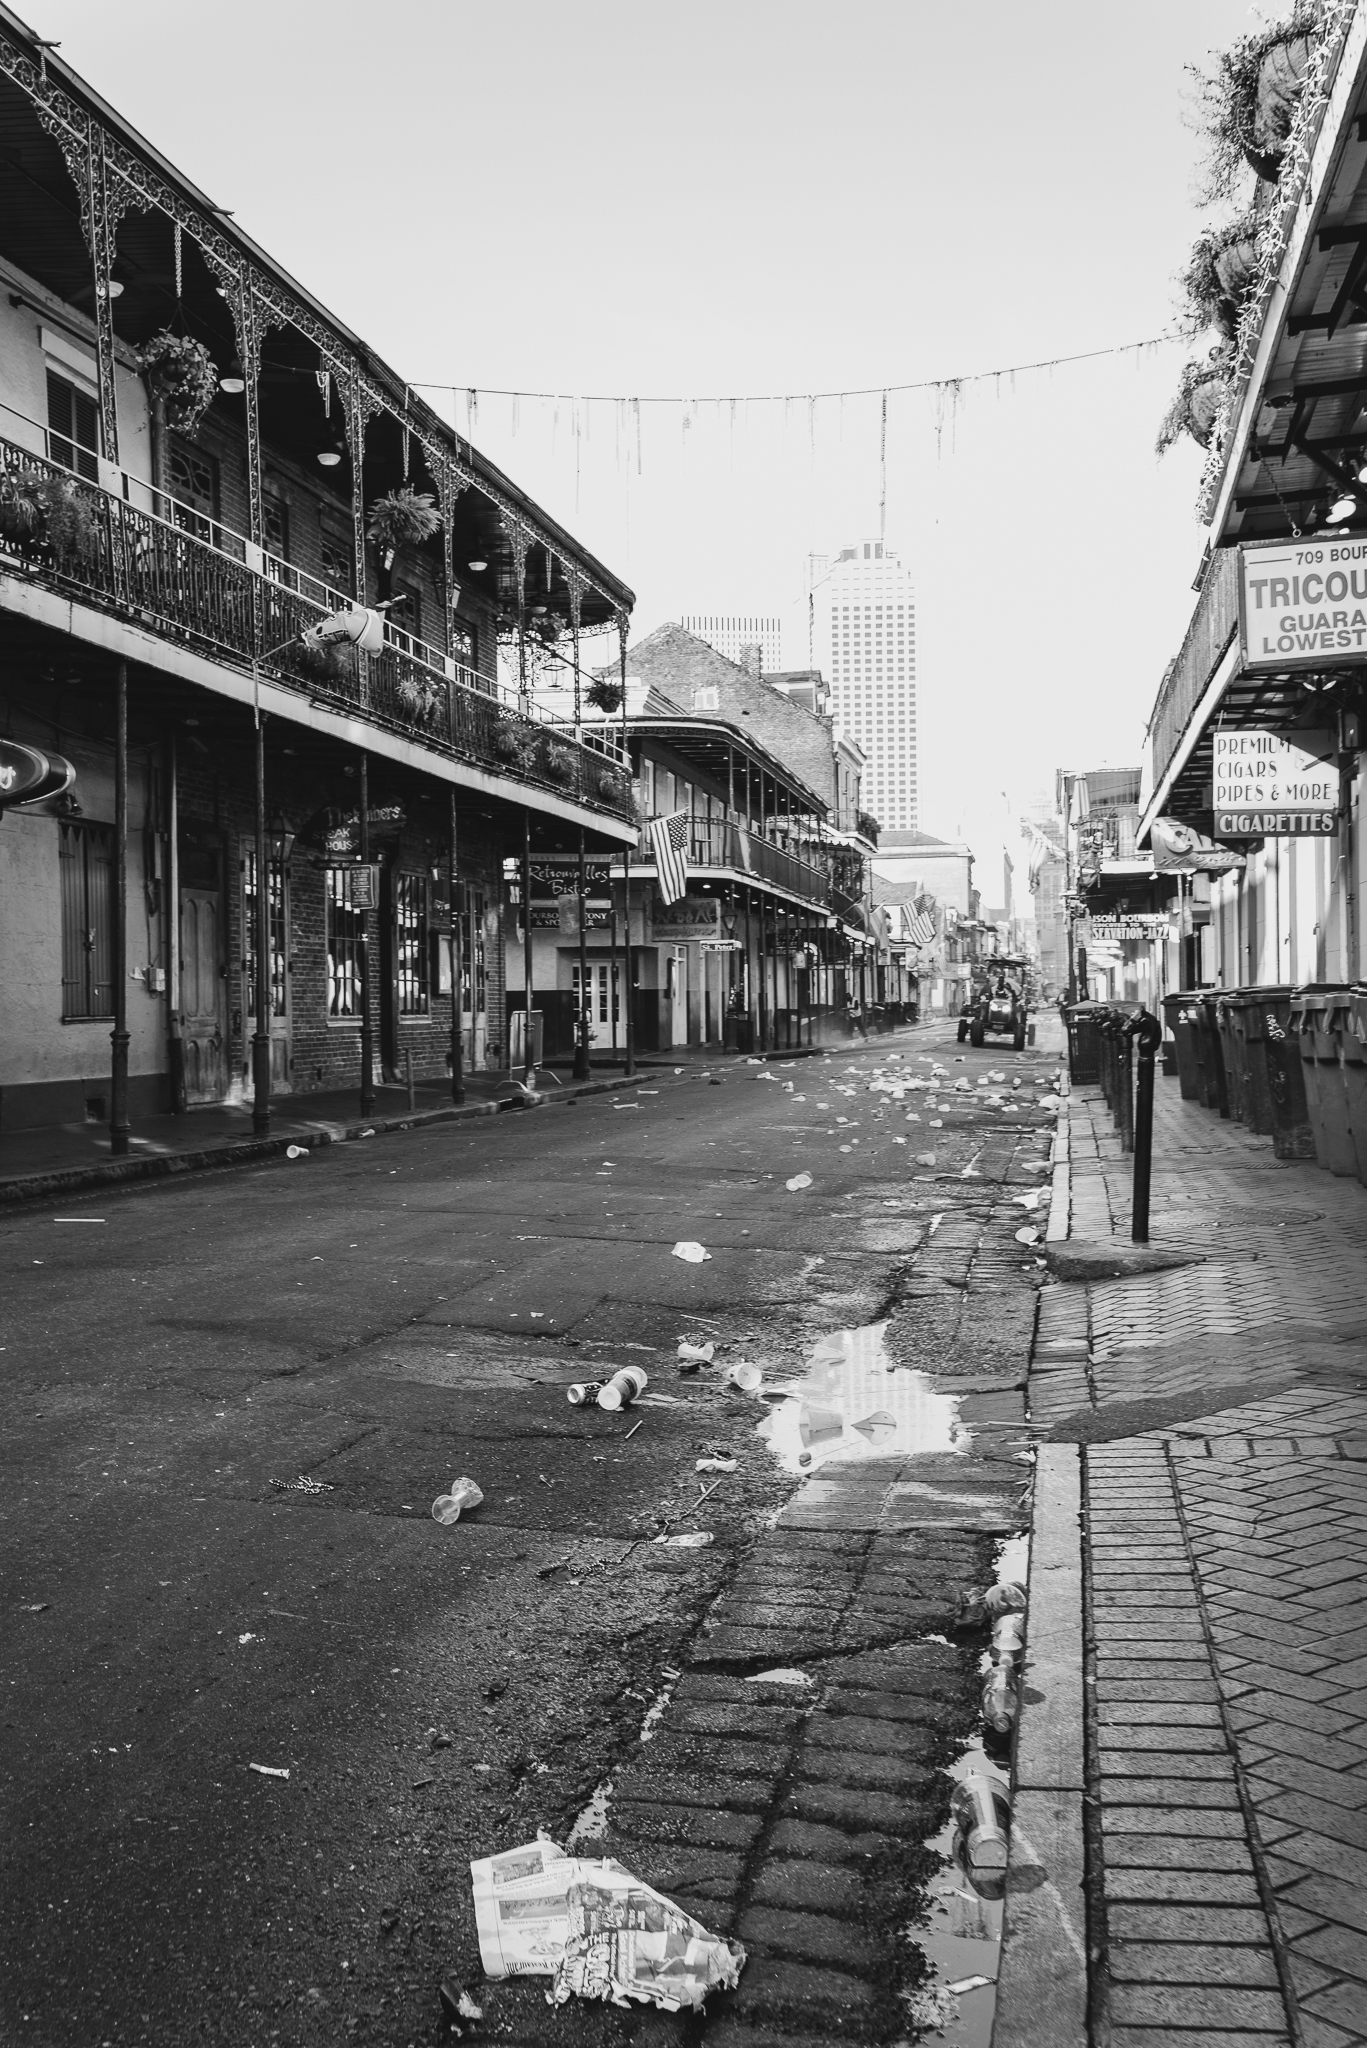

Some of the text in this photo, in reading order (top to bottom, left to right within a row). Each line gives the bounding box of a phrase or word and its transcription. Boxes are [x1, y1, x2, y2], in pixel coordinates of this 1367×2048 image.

[1296, 550, 1324, 566] 709
[1249, 569, 1367, 609] TRICOU
[1280, 609, 1367, 633] GUARA
[1263, 628, 1367, 654] LOWEST
[1217, 736, 1291, 755] PREMIUM
[1217, 760, 1278, 779] CIGARS
[1217, 783, 1332, 801] PIPES & MORE
[1219, 813, 1334, 833] CIGARETTES
[311, 827, 351, 840] STEAK
[547, 879, 592, 895] Bisto
[1120, 913, 1170, 922] BOURBON
[1092, 927, 1143, 939] SERVATION
[1146, 924, 1170, 939] JAZZ
[588, 1931, 609, 1946] THE
